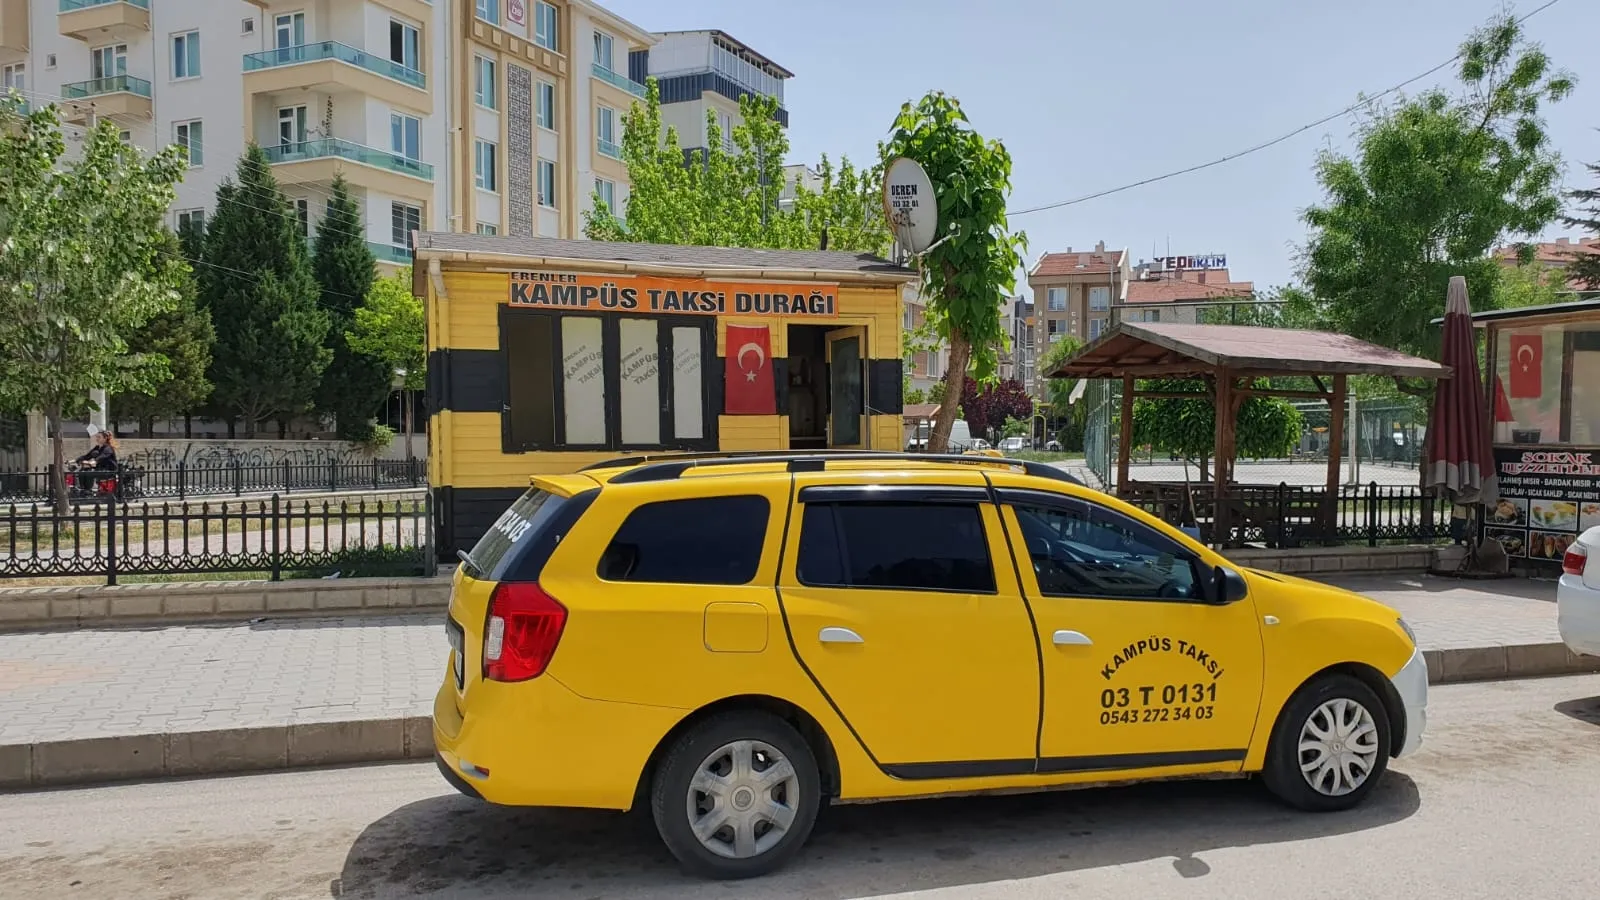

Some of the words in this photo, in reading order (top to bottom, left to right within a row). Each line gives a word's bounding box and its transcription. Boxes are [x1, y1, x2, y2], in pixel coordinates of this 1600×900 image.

[891, 185, 917, 195] DEREN
[511, 272, 577, 282] ERENLER
[511, 283, 637, 309] KAMPÜS
[736, 291, 834, 314] DURAĞI
[1521, 452, 1593, 464] SOKAK
[1544, 479, 1571, 487] BARDAK
[1101, 635, 1172, 680] KAMPÜS
[1178, 640, 1225, 680] TAKSİ
[1101, 688, 1130, 709] 03
[1139, 686, 1154, 706] T
[1162, 682, 1216, 705] 0131
[1100, 710, 1139, 725] 0543
[1142, 708, 1169, 723] 272
[1173, 706, 1191, 721] 34
[1195, 706, 1213, 720] 03
